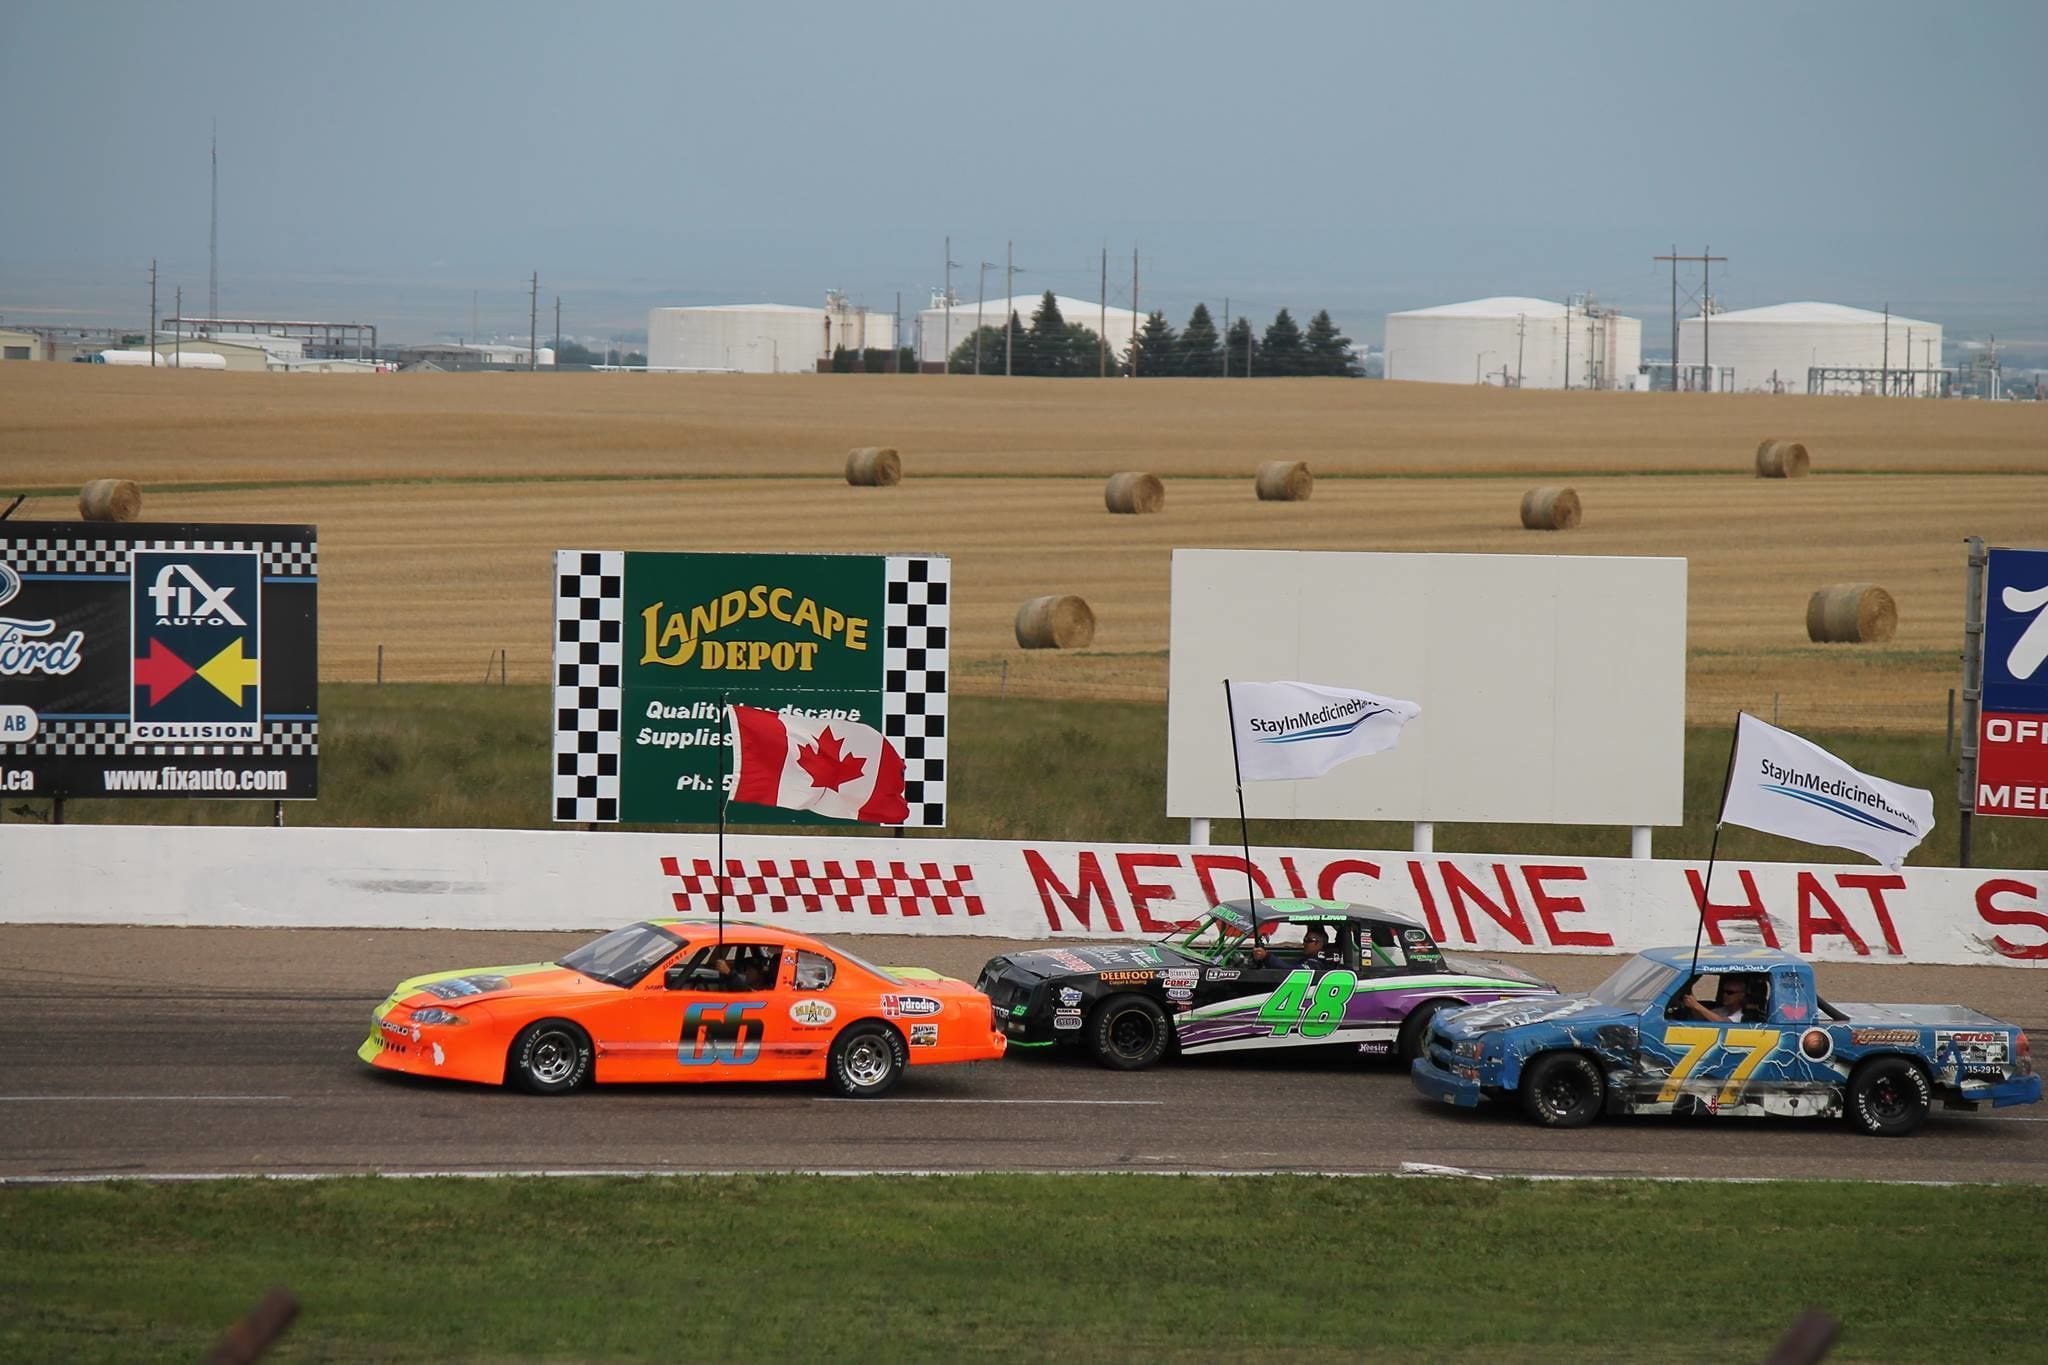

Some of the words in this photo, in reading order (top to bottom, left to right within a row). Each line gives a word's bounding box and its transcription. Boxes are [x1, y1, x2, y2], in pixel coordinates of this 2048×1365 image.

[148, 564, 248, 626] fix
[155, 617, 225, 626] AUTO
[640, 585, 868, 667] LANDSCAPE
[700, 641, 818, 671] DEPOT
[4, 715, 27, 732] AB
[646, 701, 728, 723] Quality
[137, 726, 254, 738] COLLISION
[636, 727, 733, 749] Supplies
[0, 766, 34, 791] .ca
[104, 766, 287, 791] www.fixauto.com
[1978, 784, 2048, 810] ME
[1685, 869, 1906, 956] HAT
[1100, 970, 1154, 981] DEERFOOT
[1252, 969, 1358, 1039] 48
[381, 1021, 409, 1036] CARLO
[676, 1000, 767, 1066] 66
[1359, 1043, 1388, 1052] Hoosier
[1657, 1027, 1782, 1105] 77
[1963, 1066, 2001, 1075] 35-2912
[1905, 1066, 1929, 1107] Hoosier
[1858, 1093, 1882, 1131] Hoosier
